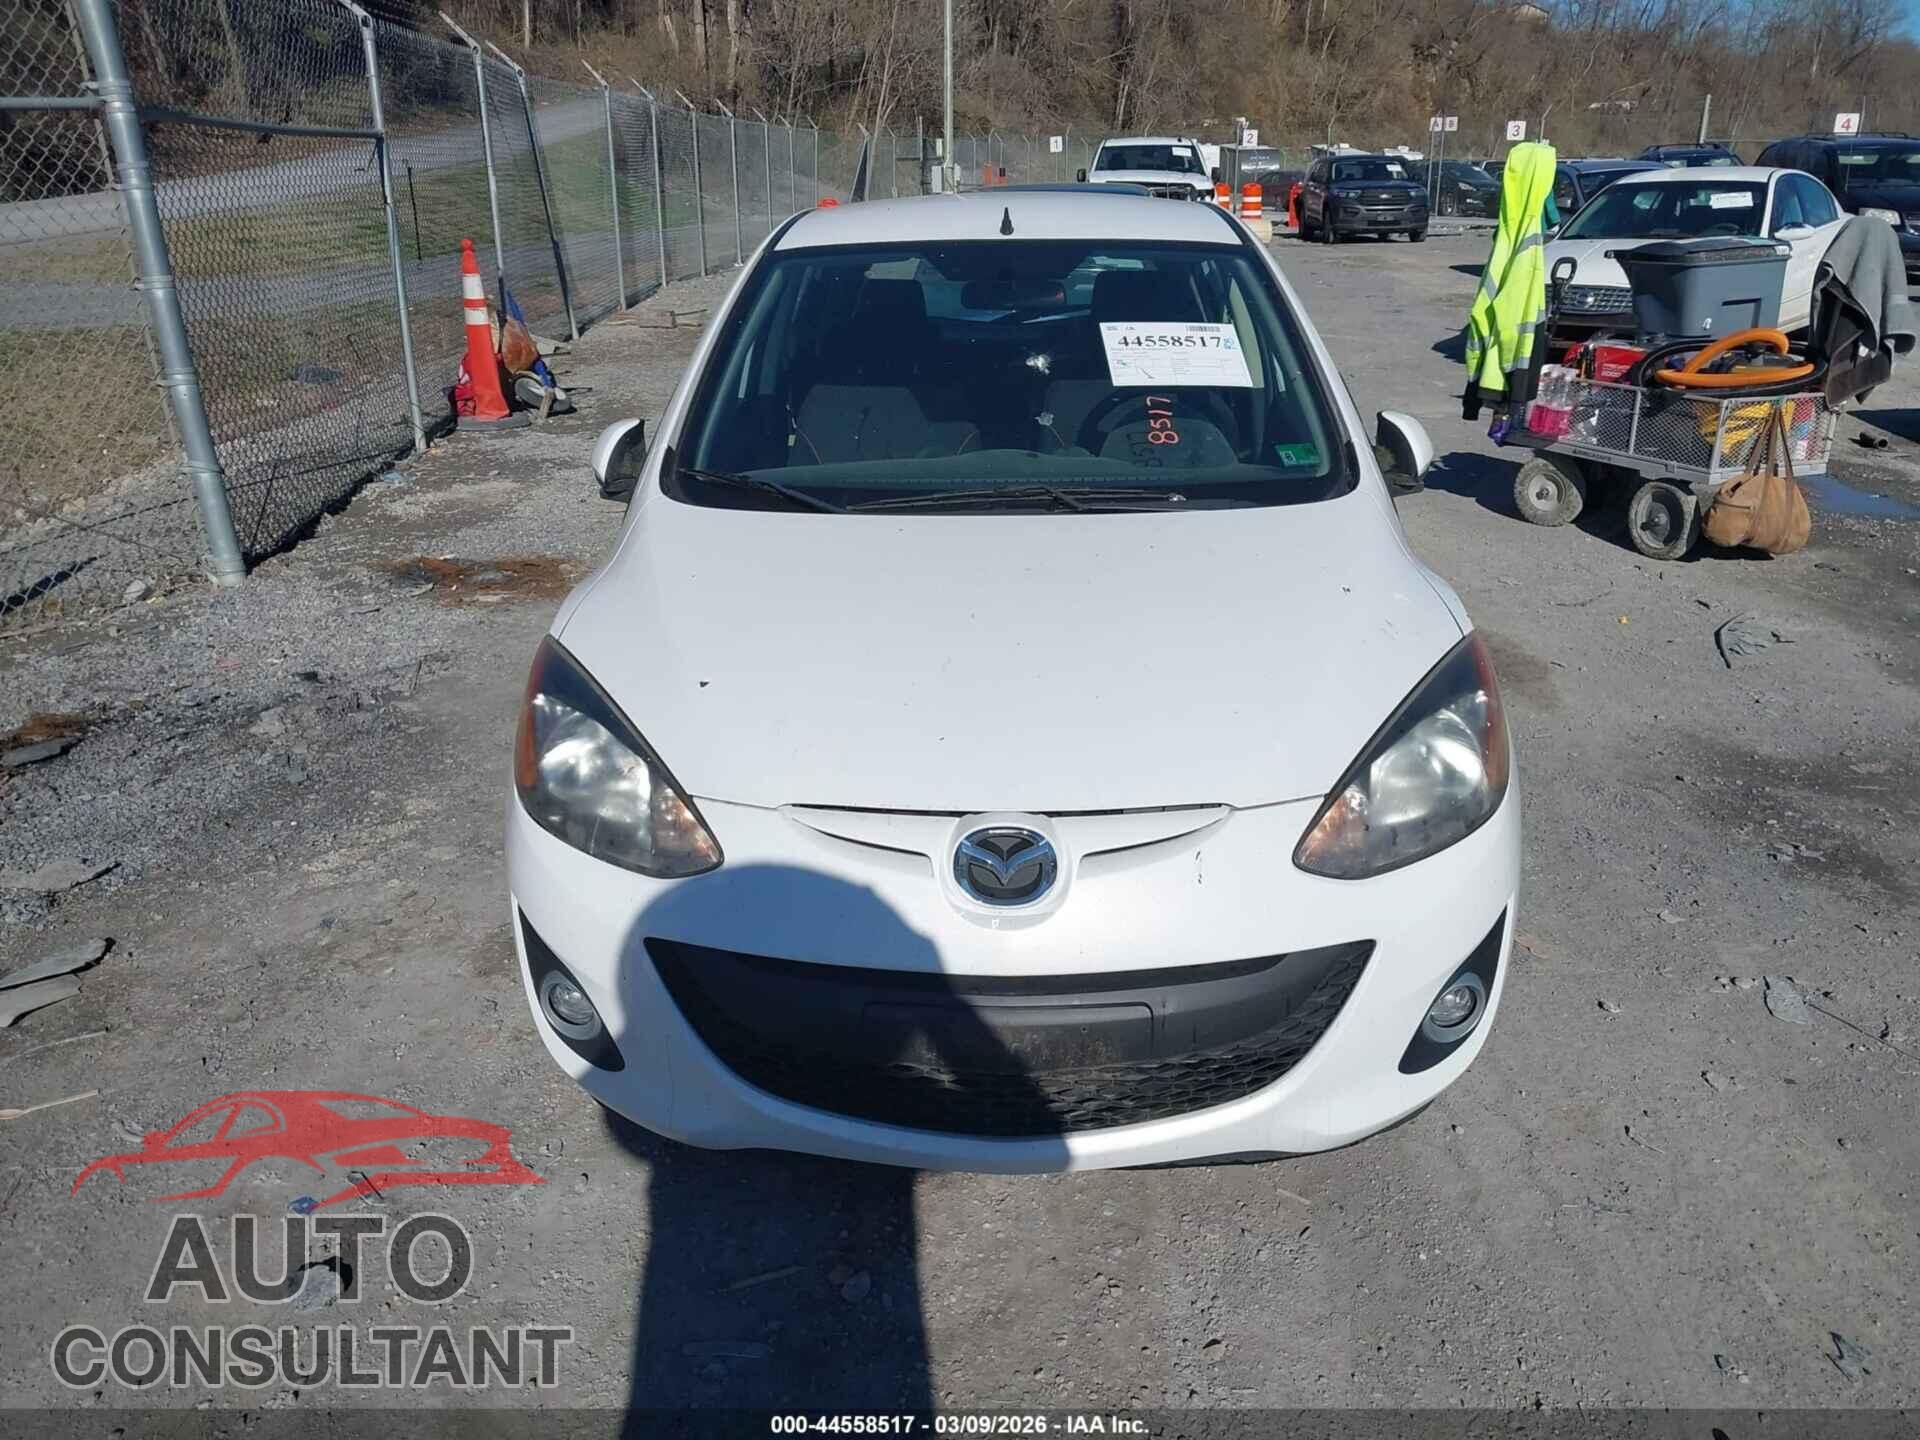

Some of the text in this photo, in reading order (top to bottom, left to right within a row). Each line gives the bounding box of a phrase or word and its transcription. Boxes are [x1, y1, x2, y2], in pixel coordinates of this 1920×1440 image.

[1511, 124, 1521, 137] 3
[1841, 117, 1852, 131] 4
[1247, 133, 1254, 144] 2
[1118, 335, 1221, 347] 44558517
[1146, 396, 1179, 444] 8517
